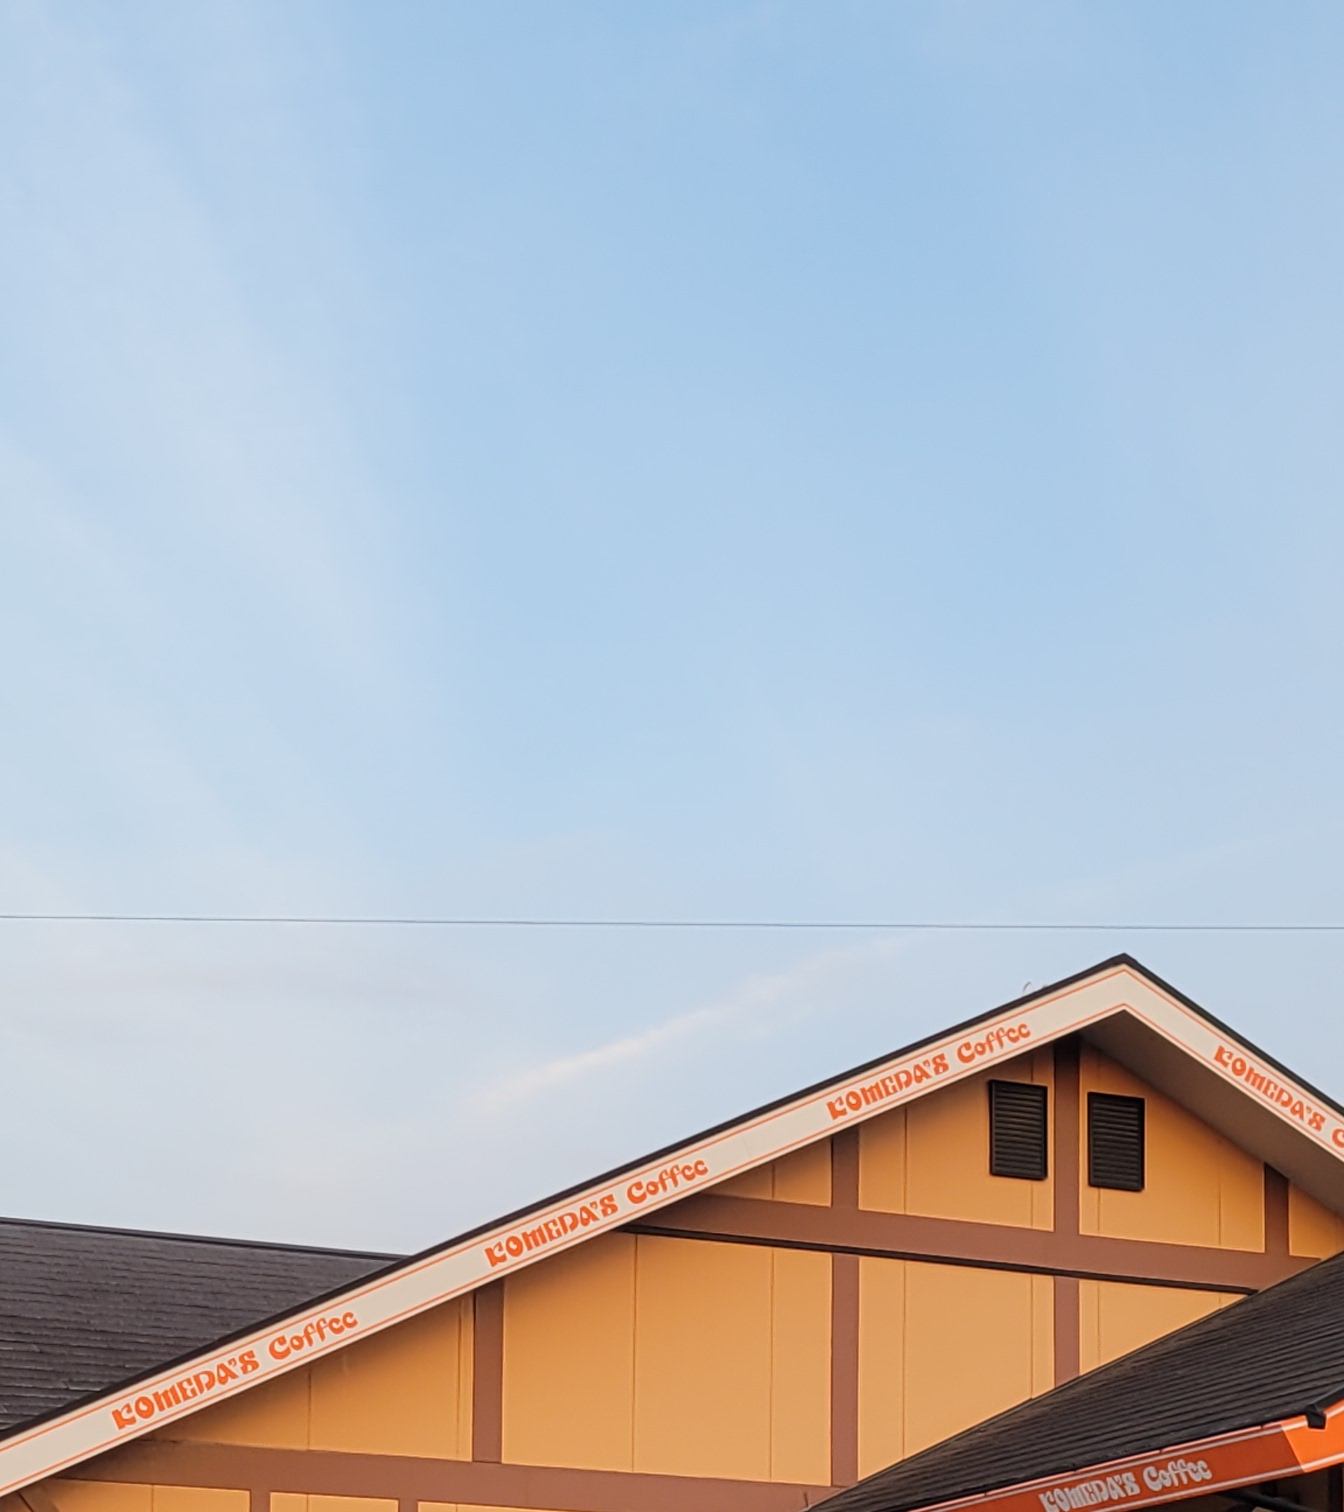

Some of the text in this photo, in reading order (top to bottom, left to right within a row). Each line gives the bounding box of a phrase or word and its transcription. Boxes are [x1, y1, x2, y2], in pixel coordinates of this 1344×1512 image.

[826, 1023, 1031, 1121] KOMEDA'S Coffee
[1213, 1045, 1326, 1132] KOMEDA'S
[484, 1159, 709, 1267] KOMEDA'S Coffee
[111, 1311, 358, 1430] KOMEDA'S Coffee
[1142, 1457, 1213, 1492] Coffee
